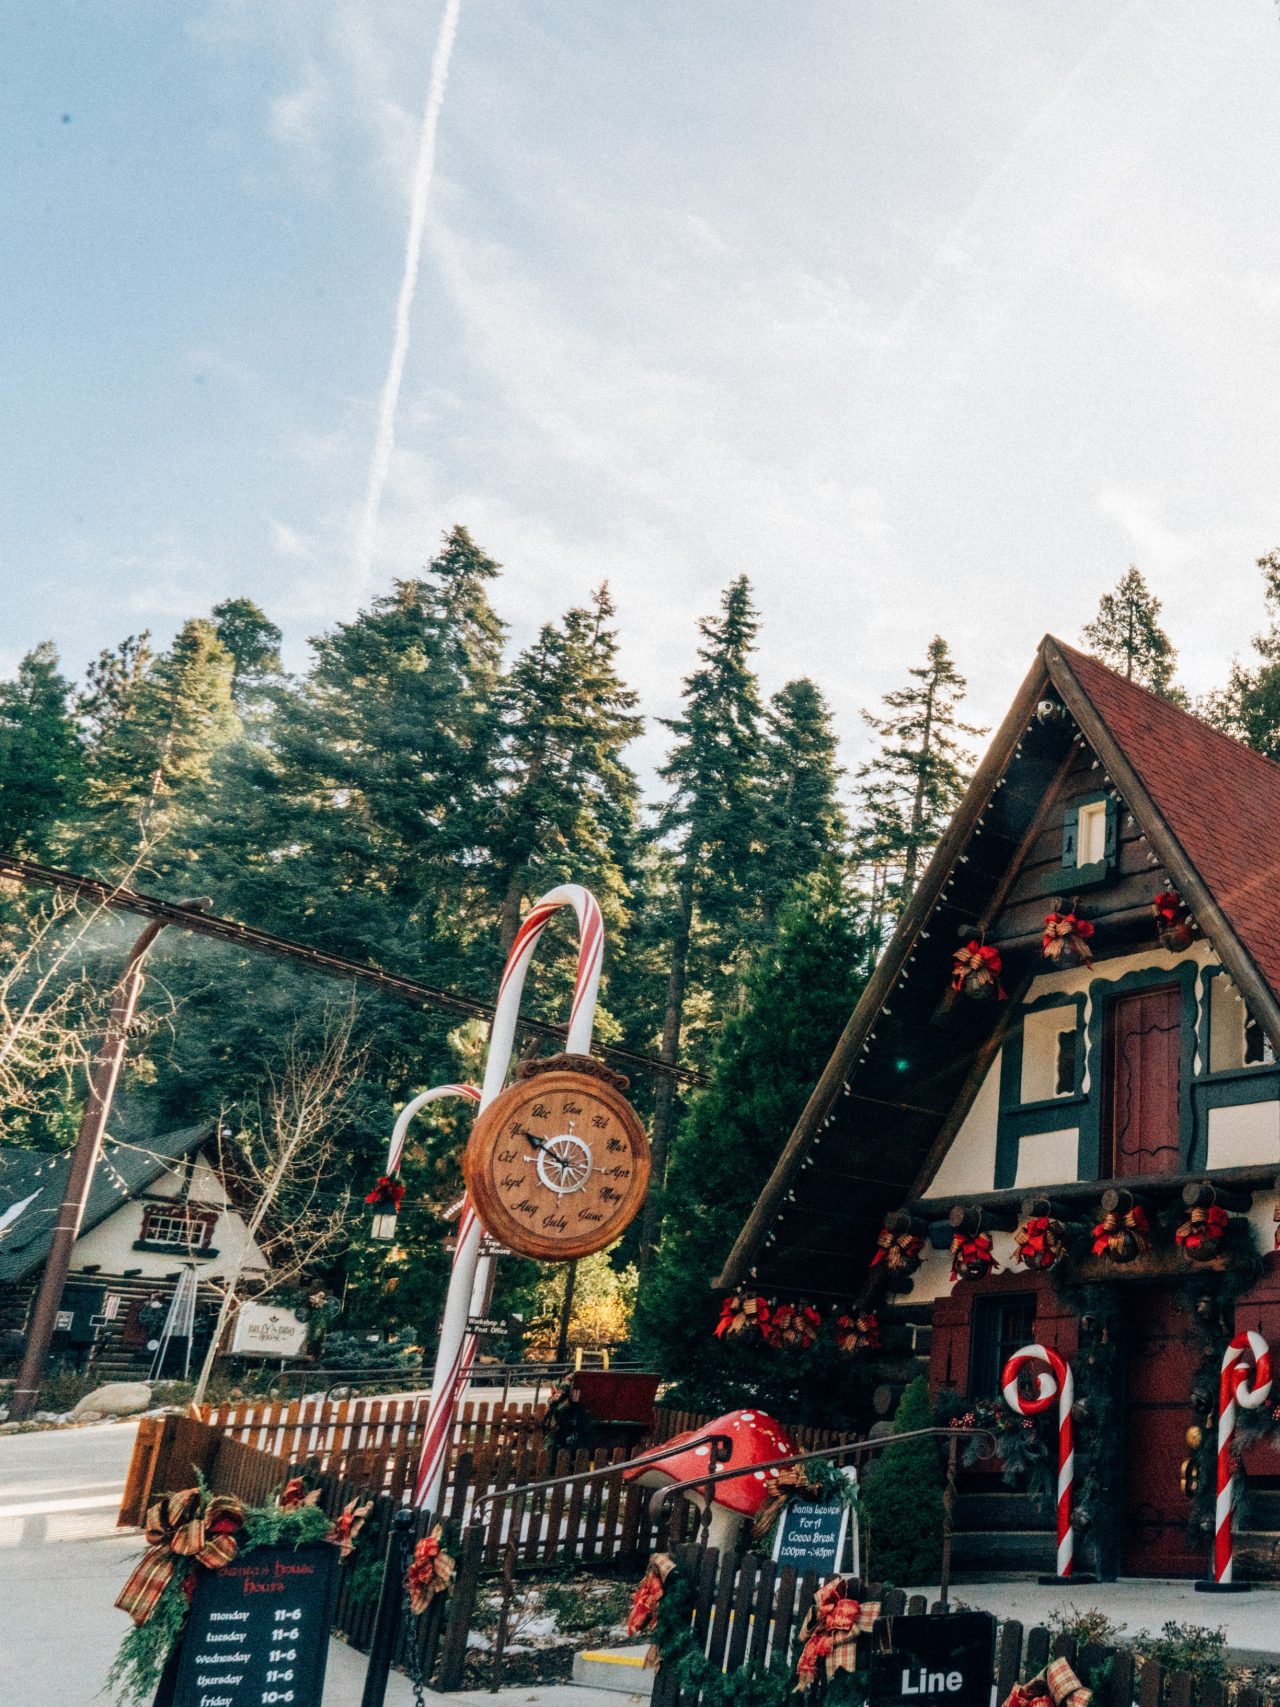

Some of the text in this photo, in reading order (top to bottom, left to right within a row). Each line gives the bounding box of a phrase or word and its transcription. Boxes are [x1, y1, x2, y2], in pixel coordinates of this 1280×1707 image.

[531, 1104, 551, 1119] Dec
[561, 1102, 583, 1115] Jan
[591, 1115, 609, 1129] Feb
[606, 1138, 627, 1153] Mar
[498, 1150, 518, 1163] Oct
[603, 1166, 630, 1181] Apr
[500, 1174, 525, 1191] Sept
[600, 1186, 622, 1205] May
[510, 1199, 539, 1218] Aug
[577, 1208, 603, 1221] June
[542, 1214, 568, 1233] July
[468, 1318, 507, 1328] Workshop &
[490, 1327, 509, 1335] Office
[792, 1504, 840, 1515] Santa Leaves
[800, 1518, 814, 1528] For
[788, 1531, 836, 1543] Cocoa Break
[209, 1608, 301, 1622] monday 11-6
[206, 1628, 299, 1643] tuesday 11-6
[195, 1649, 297, 1664] wednesday 11-6
[197, 1669, 294, 1688] thursday 11-6
[901, 1667, 963, 1695] Line
[200, 1690, 294, 1707] friday 10-6
